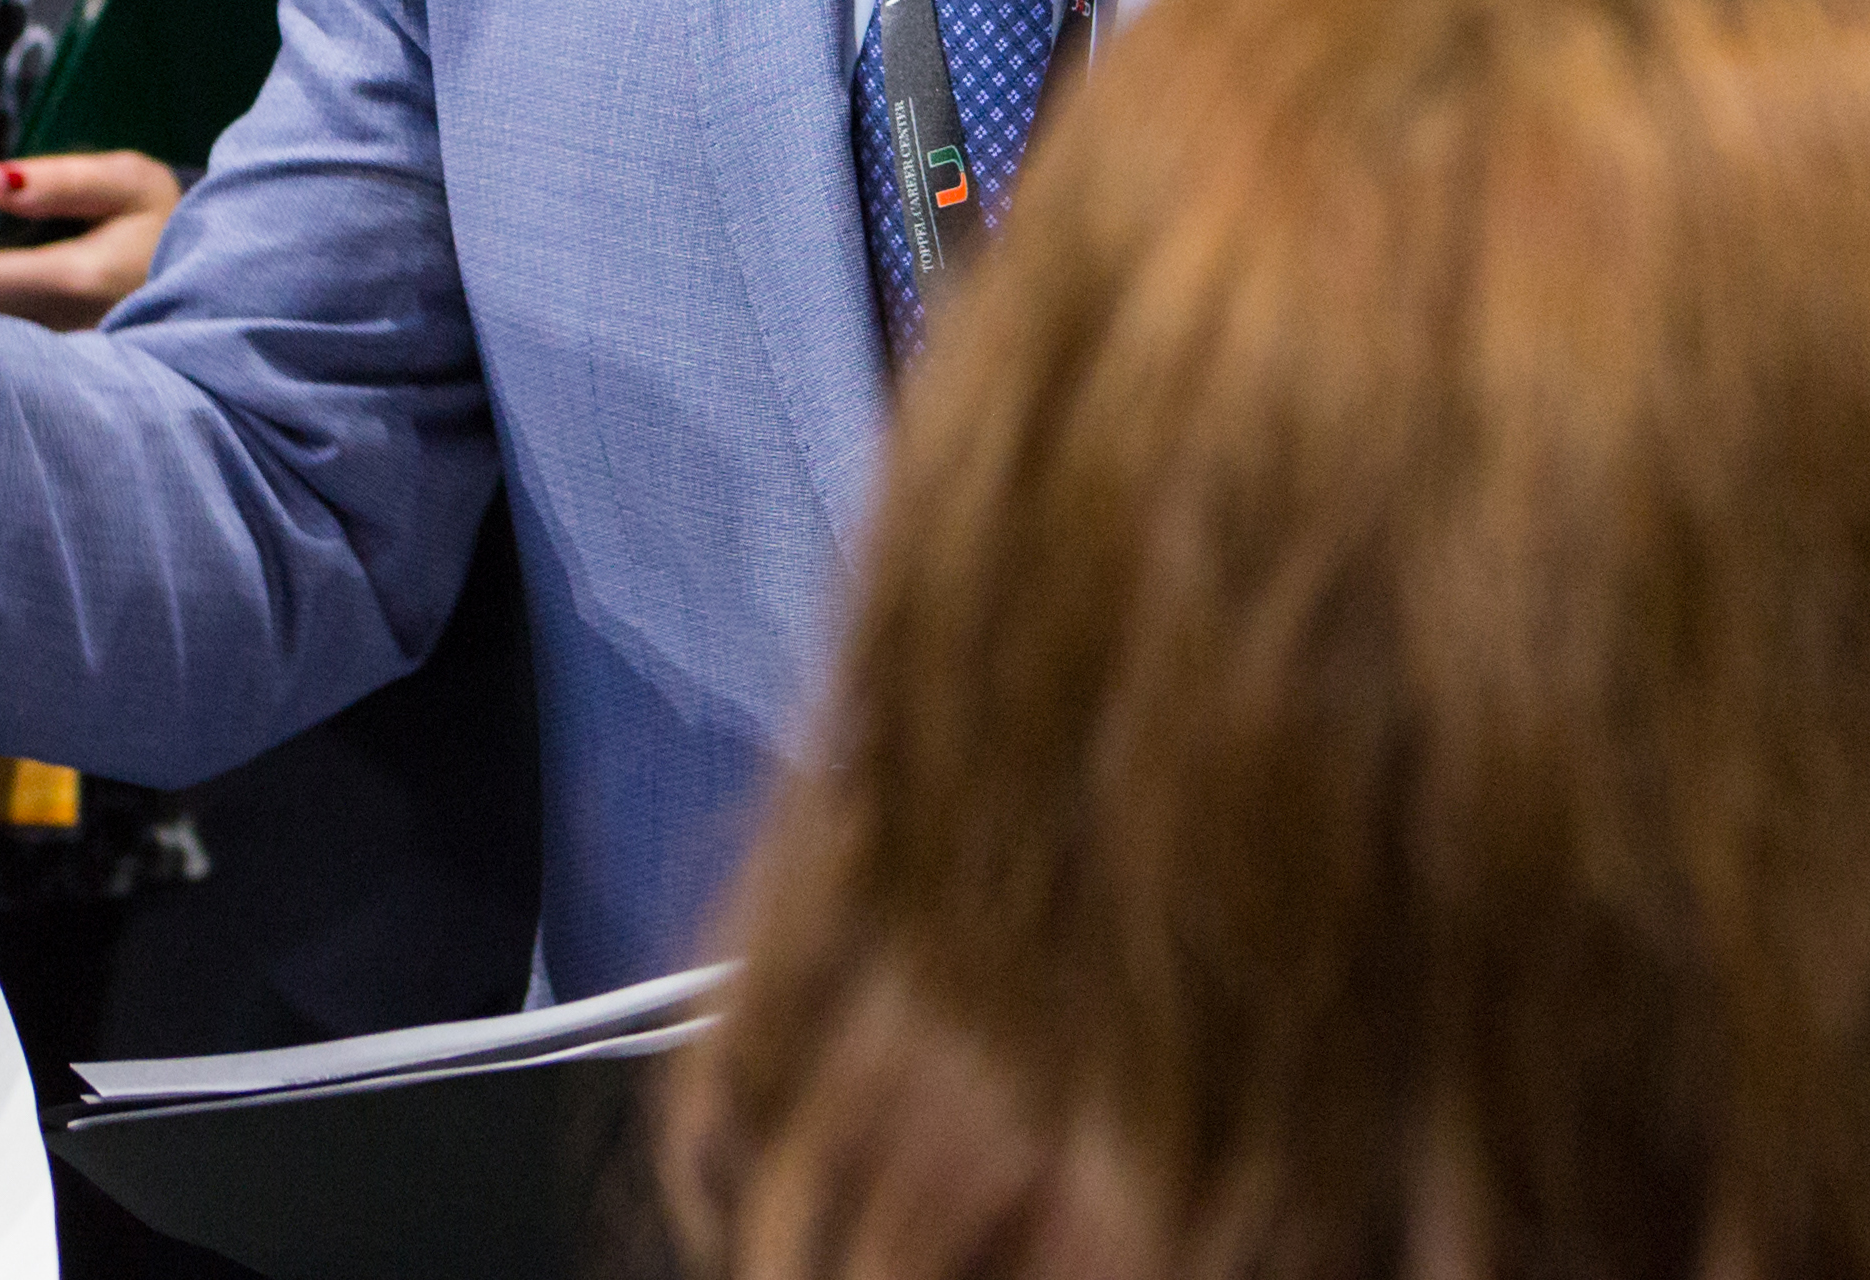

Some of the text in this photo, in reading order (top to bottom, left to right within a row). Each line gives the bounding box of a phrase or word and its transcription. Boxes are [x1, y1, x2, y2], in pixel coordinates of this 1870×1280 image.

[894, 99, 935, 274] TOPPEL CAREER CENTER
